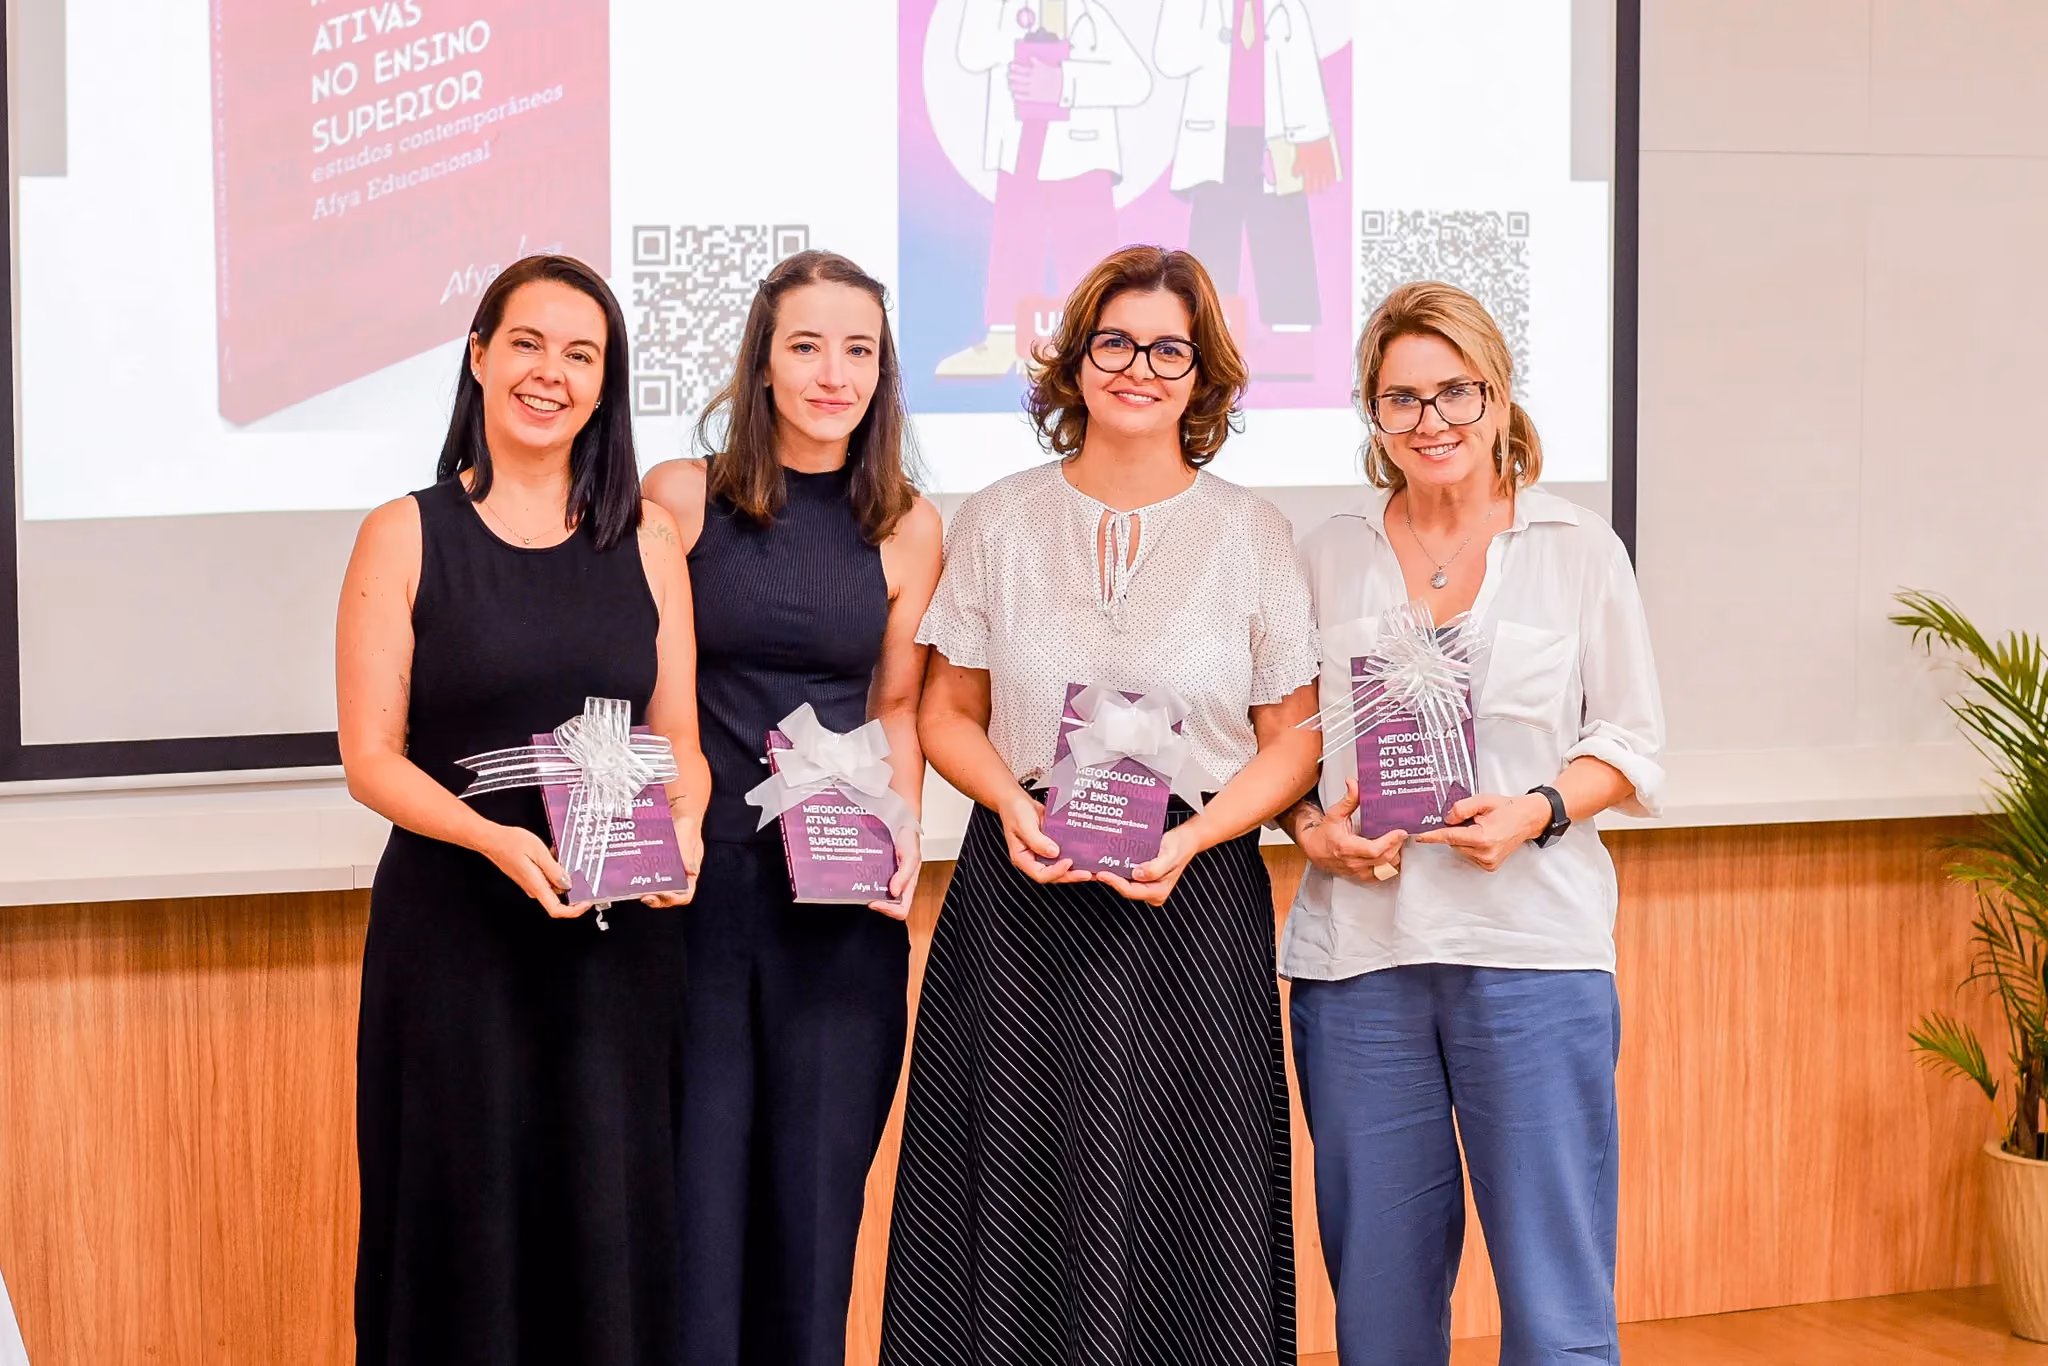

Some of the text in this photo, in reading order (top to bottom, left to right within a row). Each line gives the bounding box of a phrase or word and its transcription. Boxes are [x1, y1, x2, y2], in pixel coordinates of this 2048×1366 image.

[312, 0, 422, 55] ATIVAS
[311, 20, 491, 104] NO ENSINO
[312, 70, 484, 153] SUPERIOR
[312, 84, 564, 183] estudos contemporâneos
[312, 141, 491, 221] Afya Educacional
[440, 264, 501, 305] Afya
[1378, 729, 1458, 744] METODOLOGAS
[1379, 745, 1414, 756] ATIVAS
[1379, 755, 1435, 768] NO ENSINO
[1075, 767, 1156, 786] METODOLOGIAS
[1380, 767, 1434, 779] SUPERIOR
[1074, 778, 1109, 791] ATIVAS
[1071, 789, 1128, 806] NO ENSINO
[1382, 788, 1397, 796] Afya
[802, 805, 871, 816] METODOLOGI
[1069, 800, 1124, 817] SUPERIOR
[805, 816, 837, 825] ATIVAS
[1068, 811, 1094, 820] estudos
[1421, 815, 1442, 825] Afya
[806, 826, 859, 836] NO ENSINO
[1066, 819, 1122, 834] Afya Educacional
[808, 836, 858, 847] SUPERIOR
[1098, 856, 1120, 867] Afya
[630, 875, 652, 886] Afya
[852, 882, 871, 892] Afya
